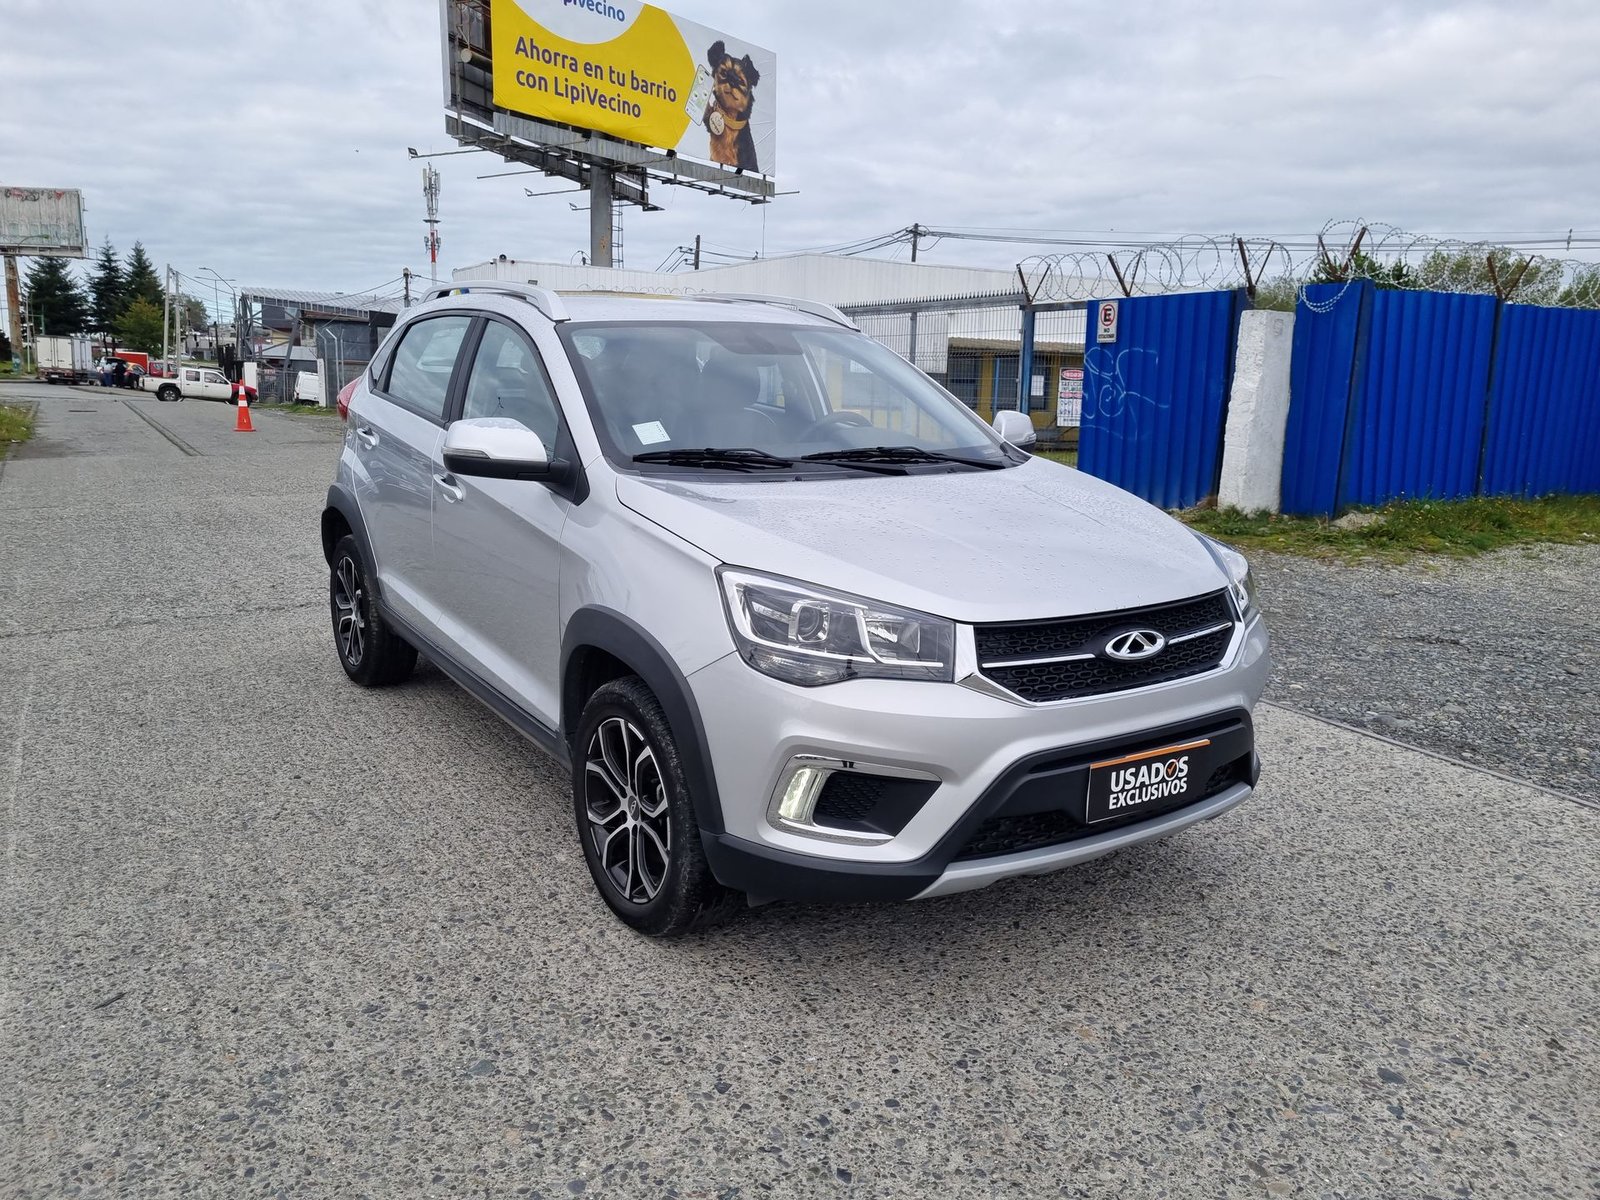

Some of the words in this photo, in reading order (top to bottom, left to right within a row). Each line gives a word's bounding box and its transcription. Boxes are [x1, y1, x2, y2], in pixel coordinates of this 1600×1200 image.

[515, 36, 578, 73] Ahorra
[583, 61, 603, 80] en
[609, 65, 625, 87] tu
[631, 70, 677, 102] barrio
[516, 70, 548, 92] con
[554, 76, 641, 118] LipiVecino
[1109, 777, 1187, 810] EXCLUSIVOS
[1110, 756, 1189, 792] USADOS
